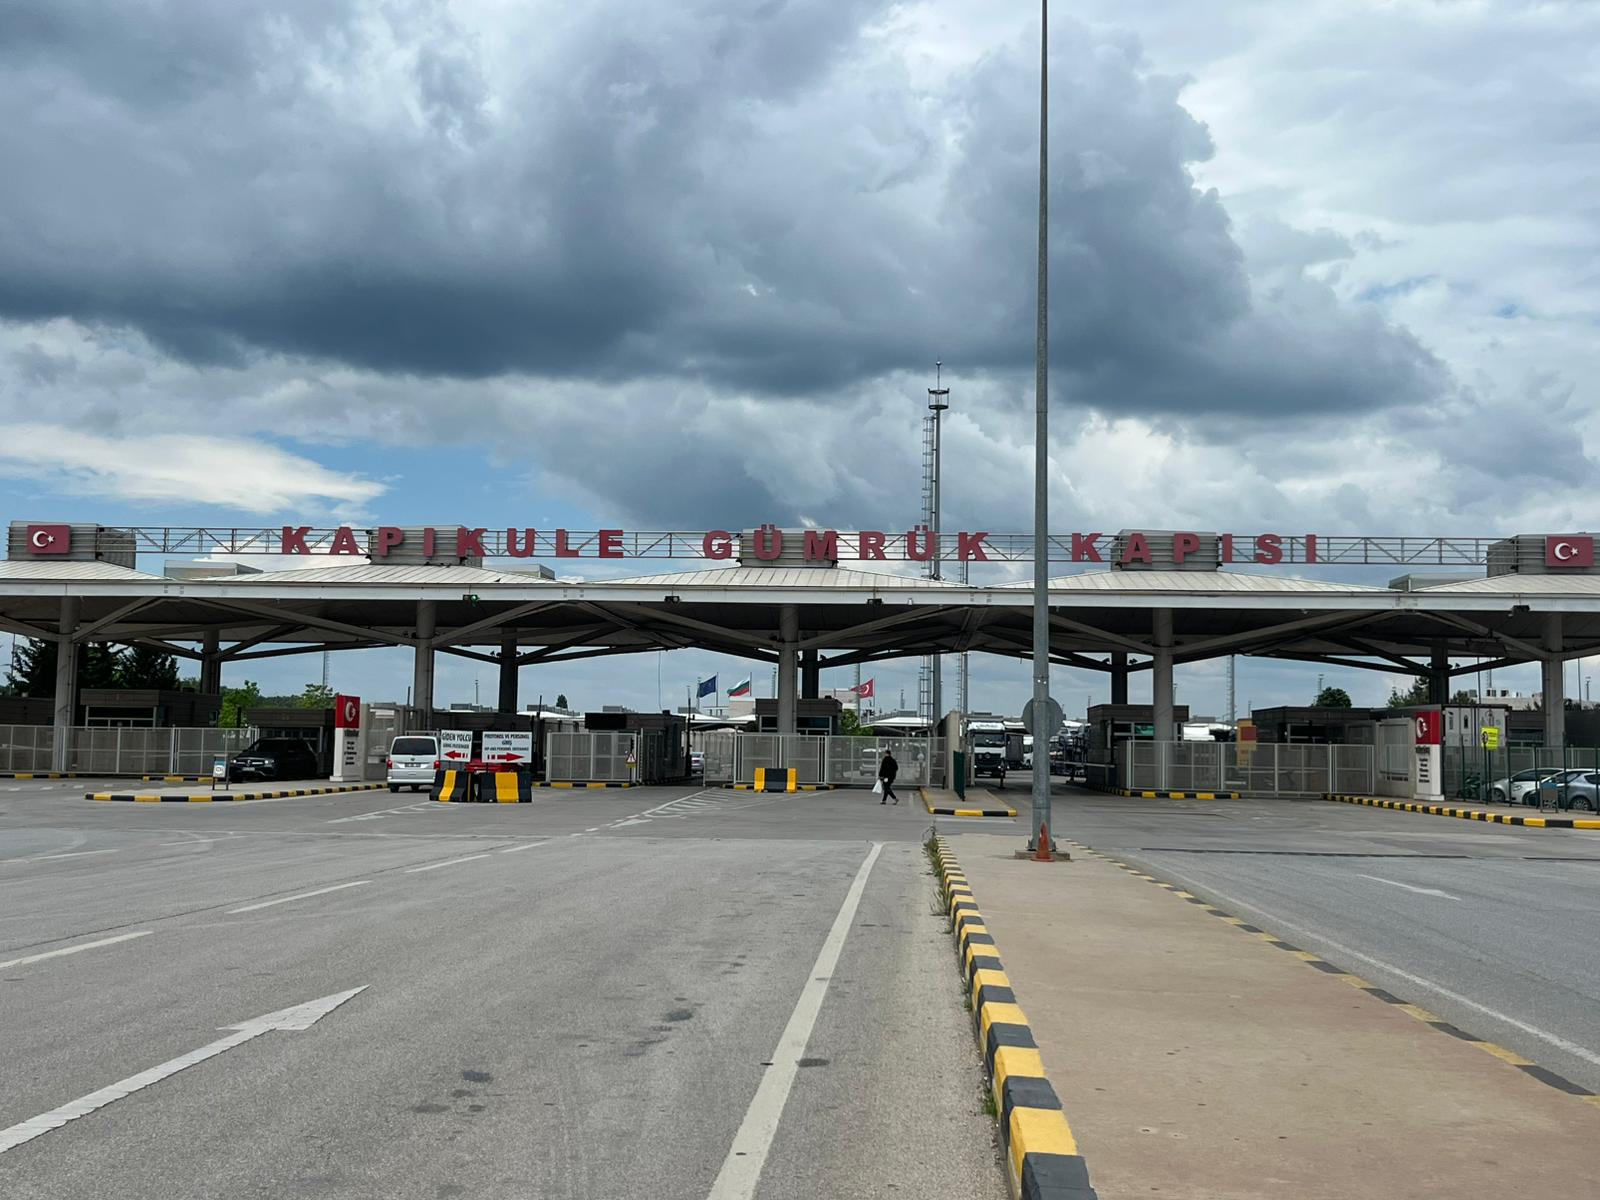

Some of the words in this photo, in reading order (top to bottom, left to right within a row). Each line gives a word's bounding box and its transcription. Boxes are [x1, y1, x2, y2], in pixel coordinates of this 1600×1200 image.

[283, 527, 624, 558] KAPIKULE
[705, 525, 989, 562] GÜMRÜK
[1073, 534, 1316, 563] KAPISI
